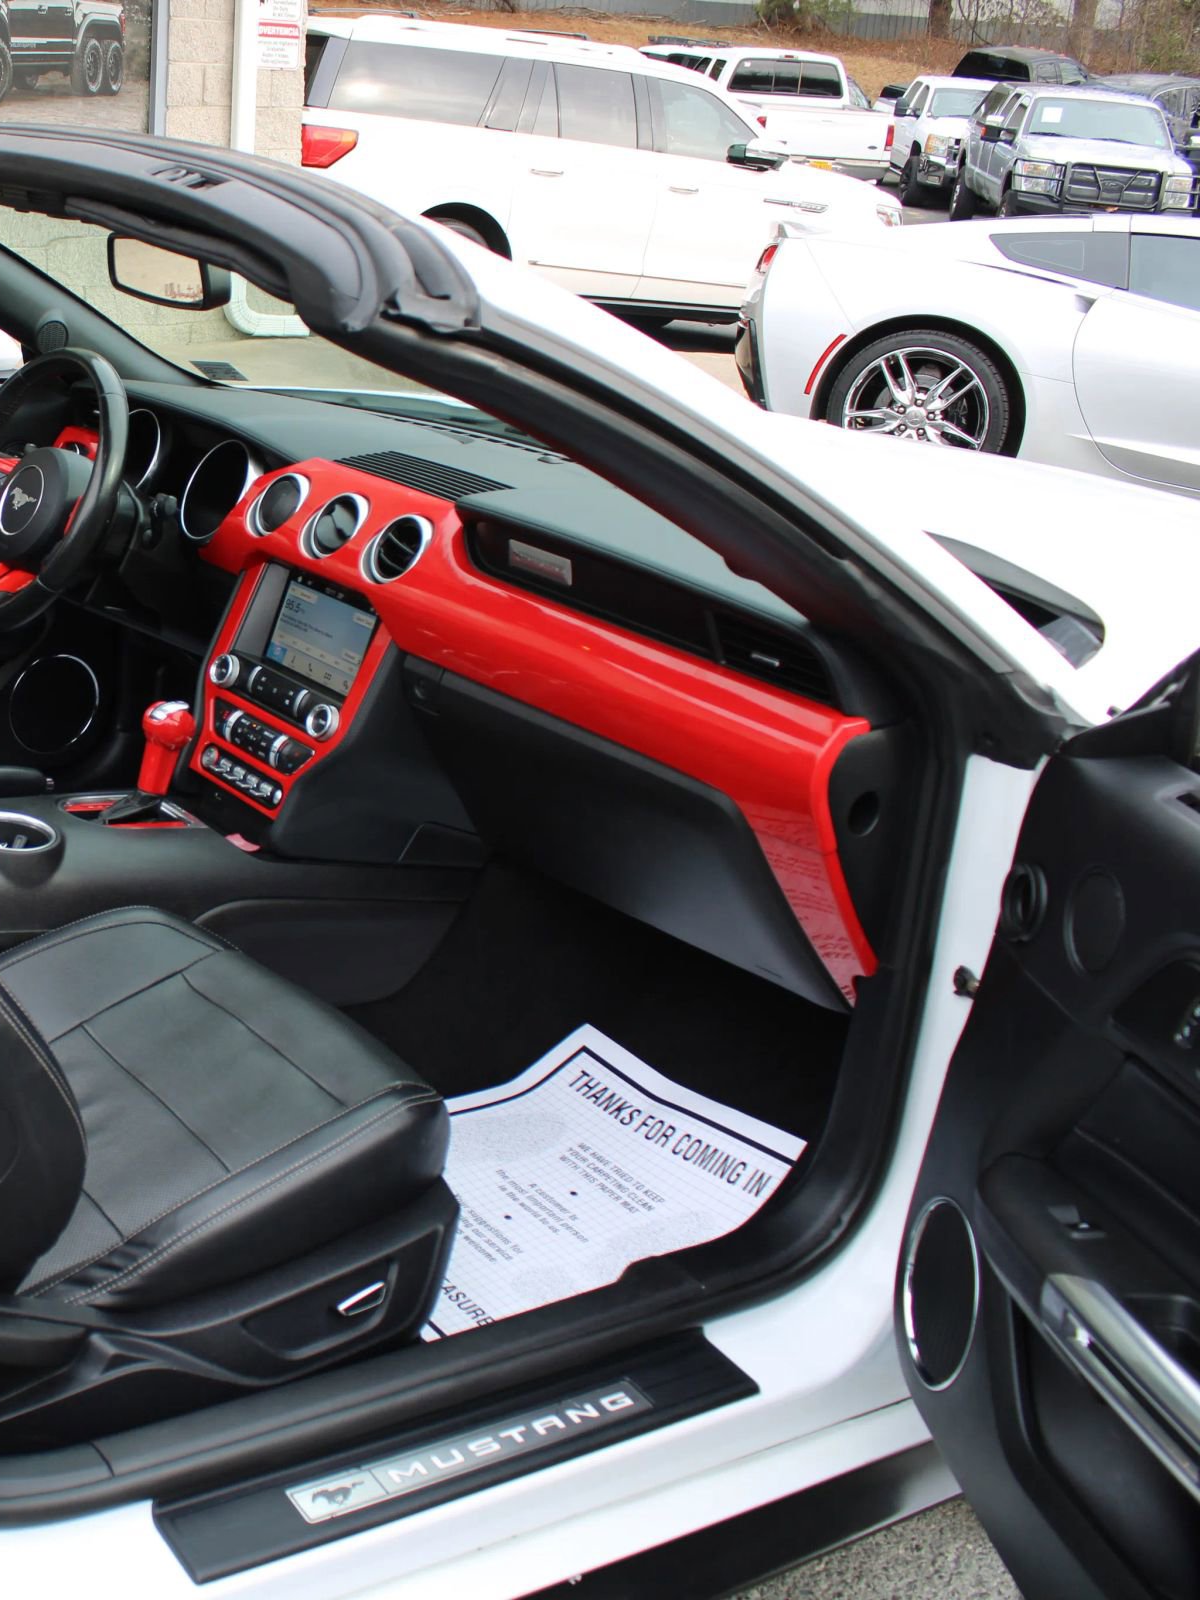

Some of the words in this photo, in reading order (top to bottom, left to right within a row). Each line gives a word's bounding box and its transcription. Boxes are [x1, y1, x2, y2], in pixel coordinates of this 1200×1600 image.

[257, 25, 299, 37] DVERTENCIA
[569, 1069, 642, 1126] THANKS
[634, 1114, 677, 1148] FOR
[671, 1133, 747, 1186] COMING
[742, 1169, 773, 1198] IN
[534, 1188, 571, 1216] customer
[559, 1154, 581, 1170] WITH
[579, 1168, 598, 1184] THIS
[595, 1182, 623, 1201] PAPER
[620, 1200, 640, 1214] MAT
[567, 1147, 589, 1163] YOUR
[586, 1162, 630, 1193] CARPETING
[627, 1191, 656, 1212] CLEAN
[589, 1151, 612, 1167] HAVE
[610, 1164, 634, 1183] TRIED
[632, 1181, 646, 1191] TO
[642, 1188, 665, 1203] KEEP
[467, 1209, 512, 1245] suggestions
[507, 1180, 528, 1195] most
[526, 1194, 565, 1224] important
[560, 1221, 590, 1243] person
[519, 1202, 542, 1219] world
[483, 1239, 514, 1260] service
[442, 1277, 496, 1327] ASURE
[386, 1391, 635, 1485] MUSTANG
